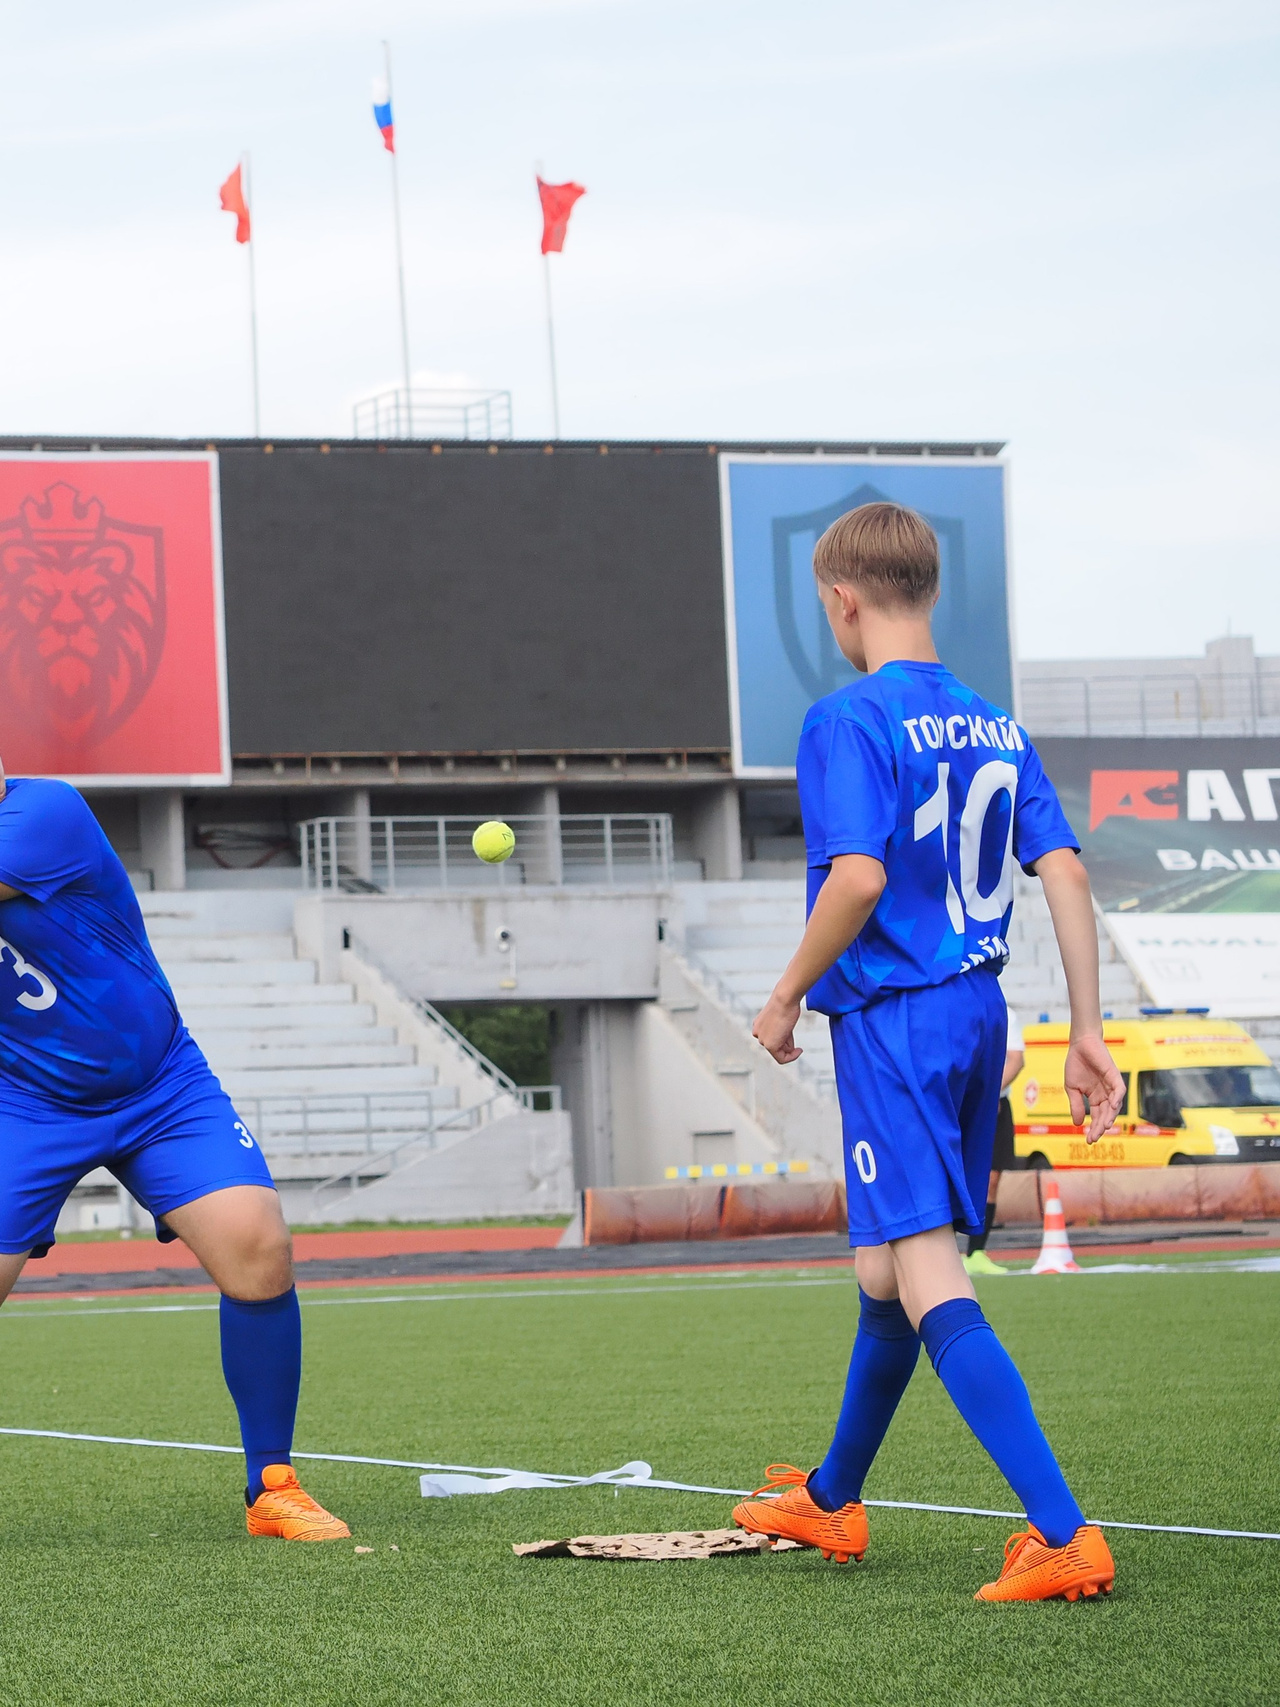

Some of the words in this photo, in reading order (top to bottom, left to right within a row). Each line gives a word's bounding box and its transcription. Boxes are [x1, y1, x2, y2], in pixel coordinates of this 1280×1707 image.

[913, 759, 1019, 936] 10
[233, 1121, 254, 1149] 3
[849, 1140, 877, 1184] 0
